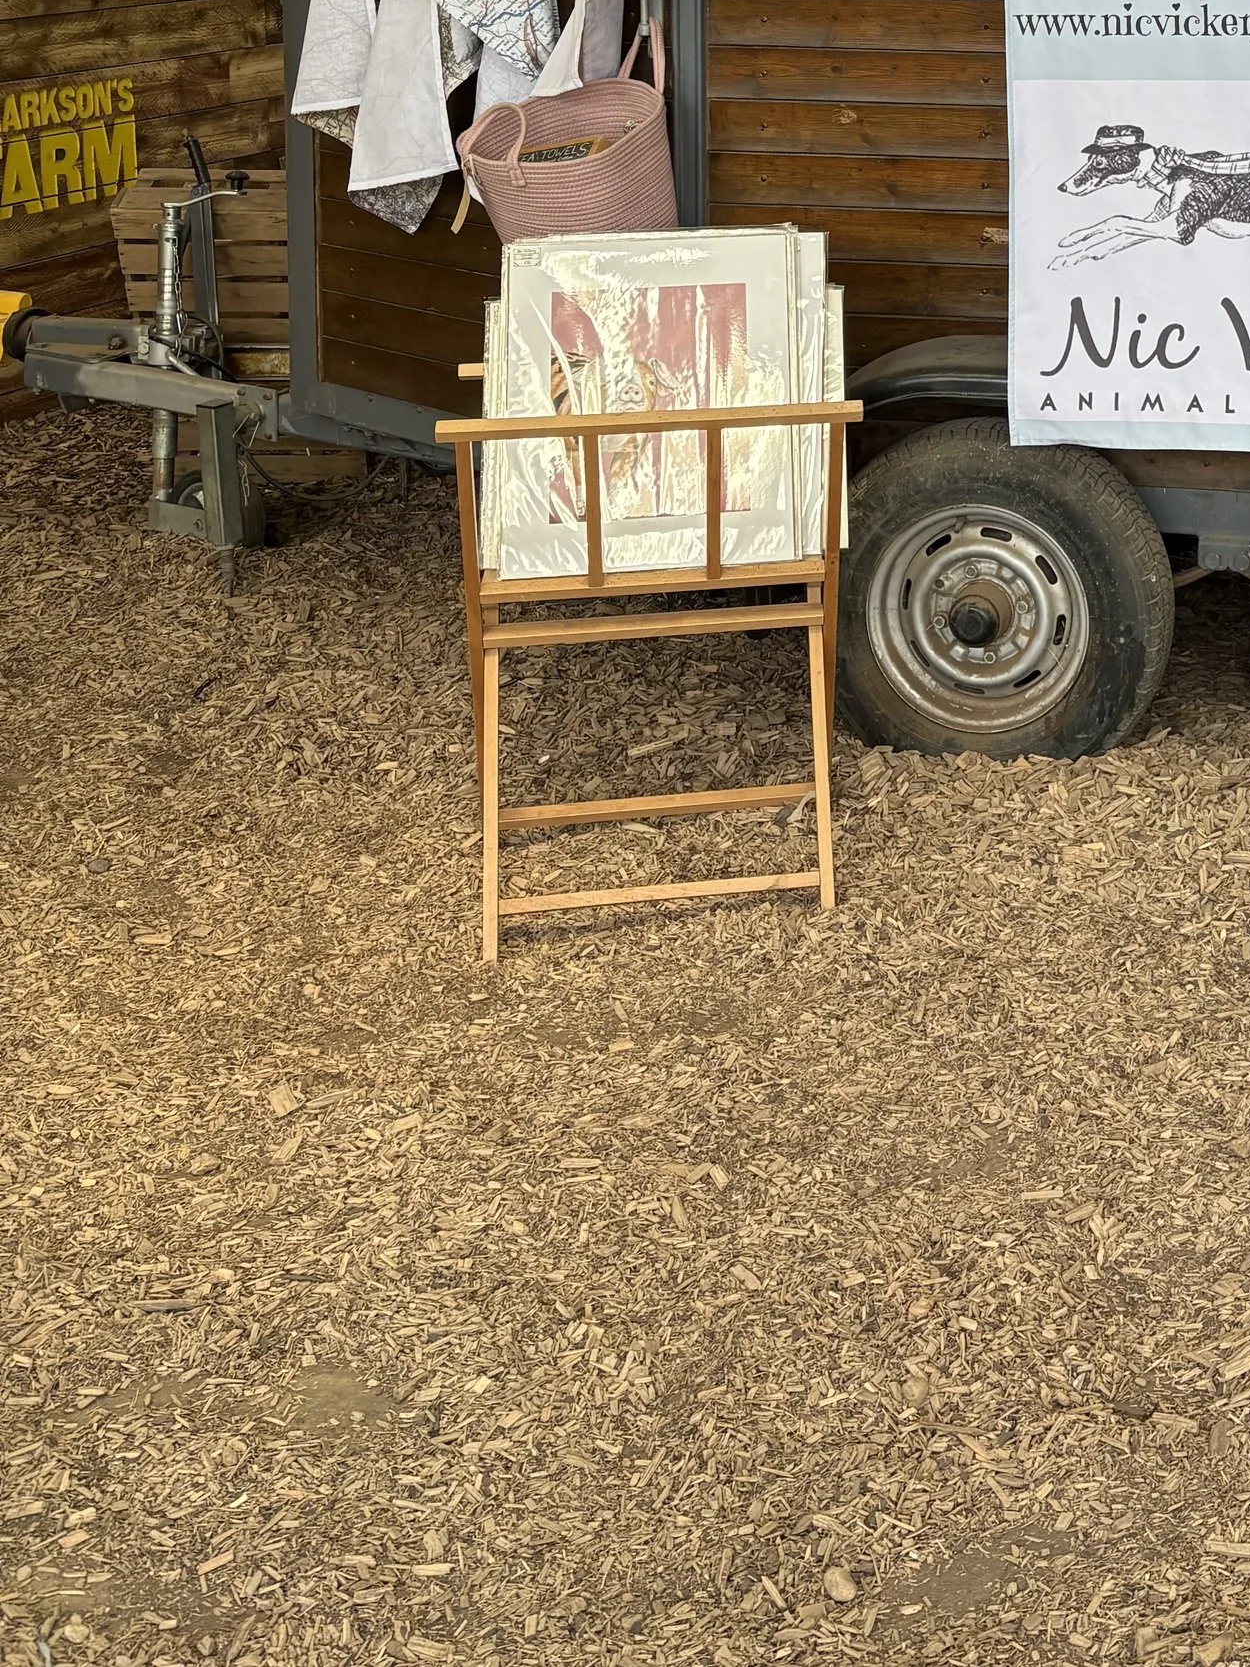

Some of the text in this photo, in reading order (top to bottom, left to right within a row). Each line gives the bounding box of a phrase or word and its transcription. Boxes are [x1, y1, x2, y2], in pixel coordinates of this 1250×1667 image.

[0, 77, 135, 132] ARKSON'S
[0, 114, 138, 220] ARM
[541, 142, 590, 161] TOWELS
[1040, 296, 1201, 377] Nic
[1040, 391, 1235, 415] ANIMAL
